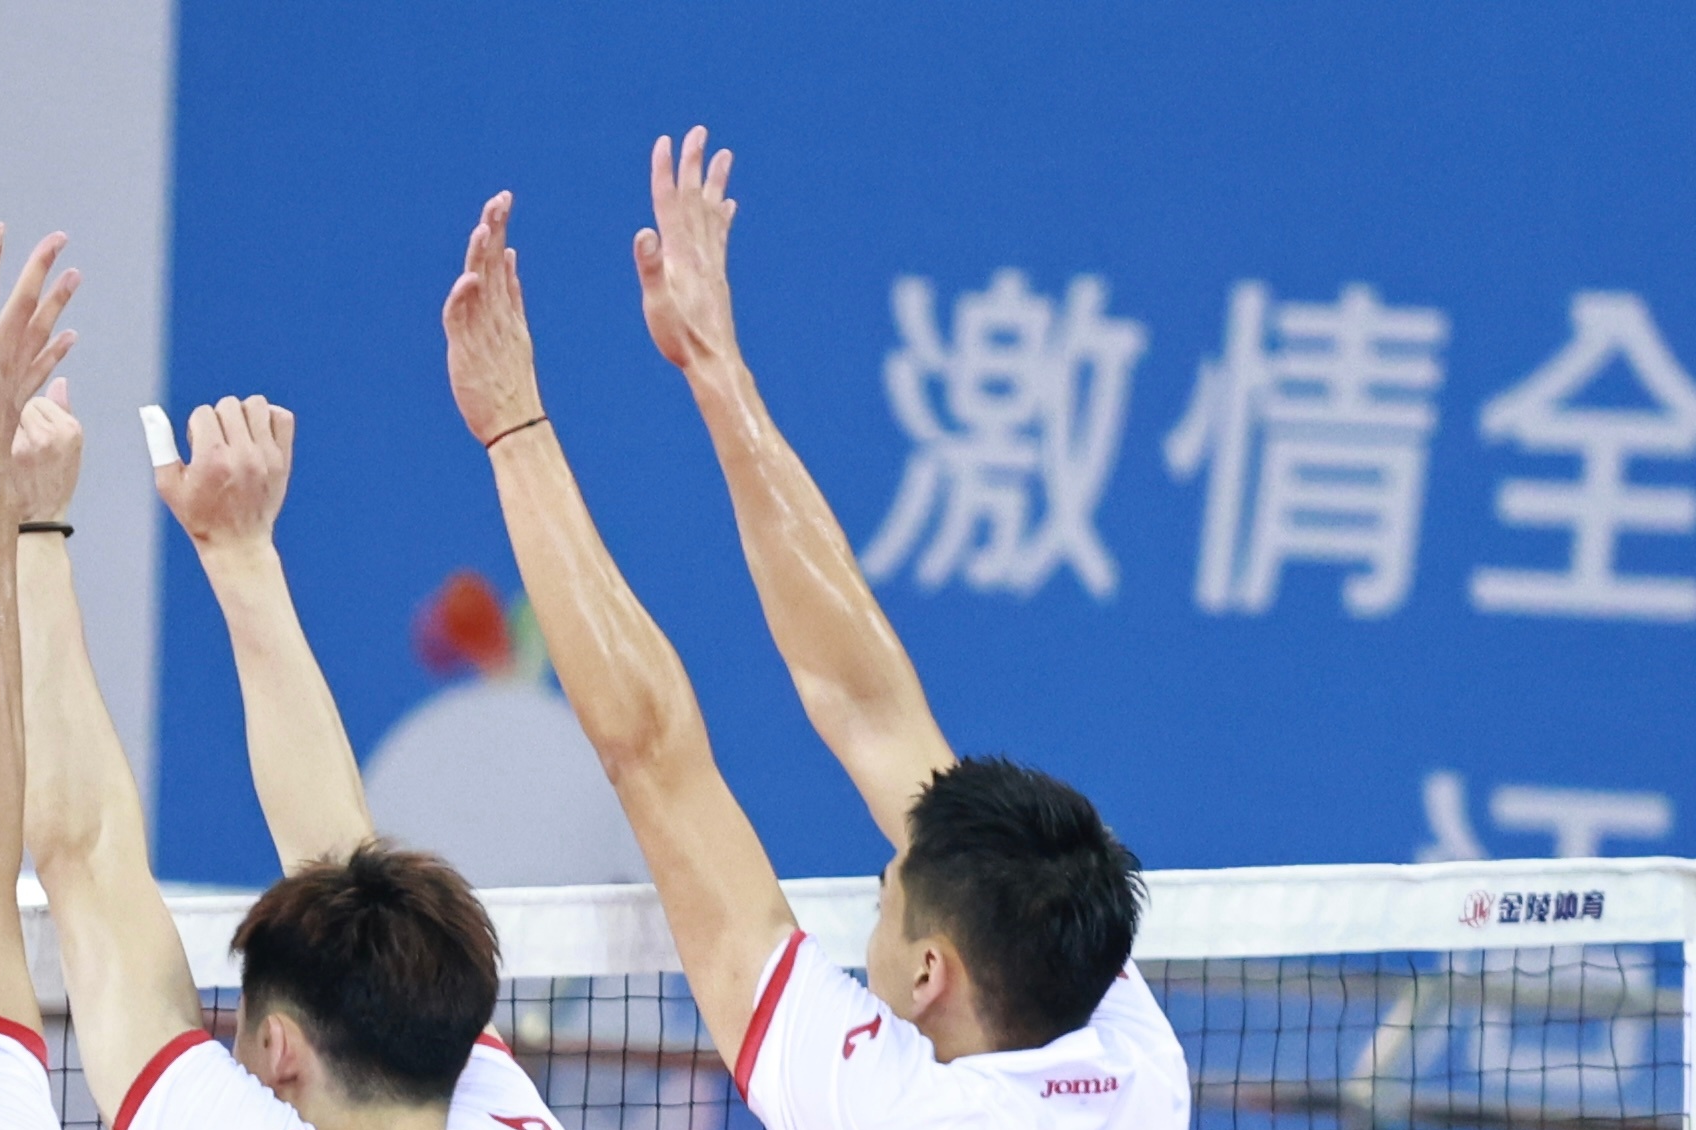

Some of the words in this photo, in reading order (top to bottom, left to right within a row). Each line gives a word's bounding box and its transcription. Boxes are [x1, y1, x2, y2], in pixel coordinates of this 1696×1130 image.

[860, 266, 1696, 622] 激情全
[1498, 890, 1605, 923] 金陵体育
[1040, 1074, 1119, 1099] Joma
